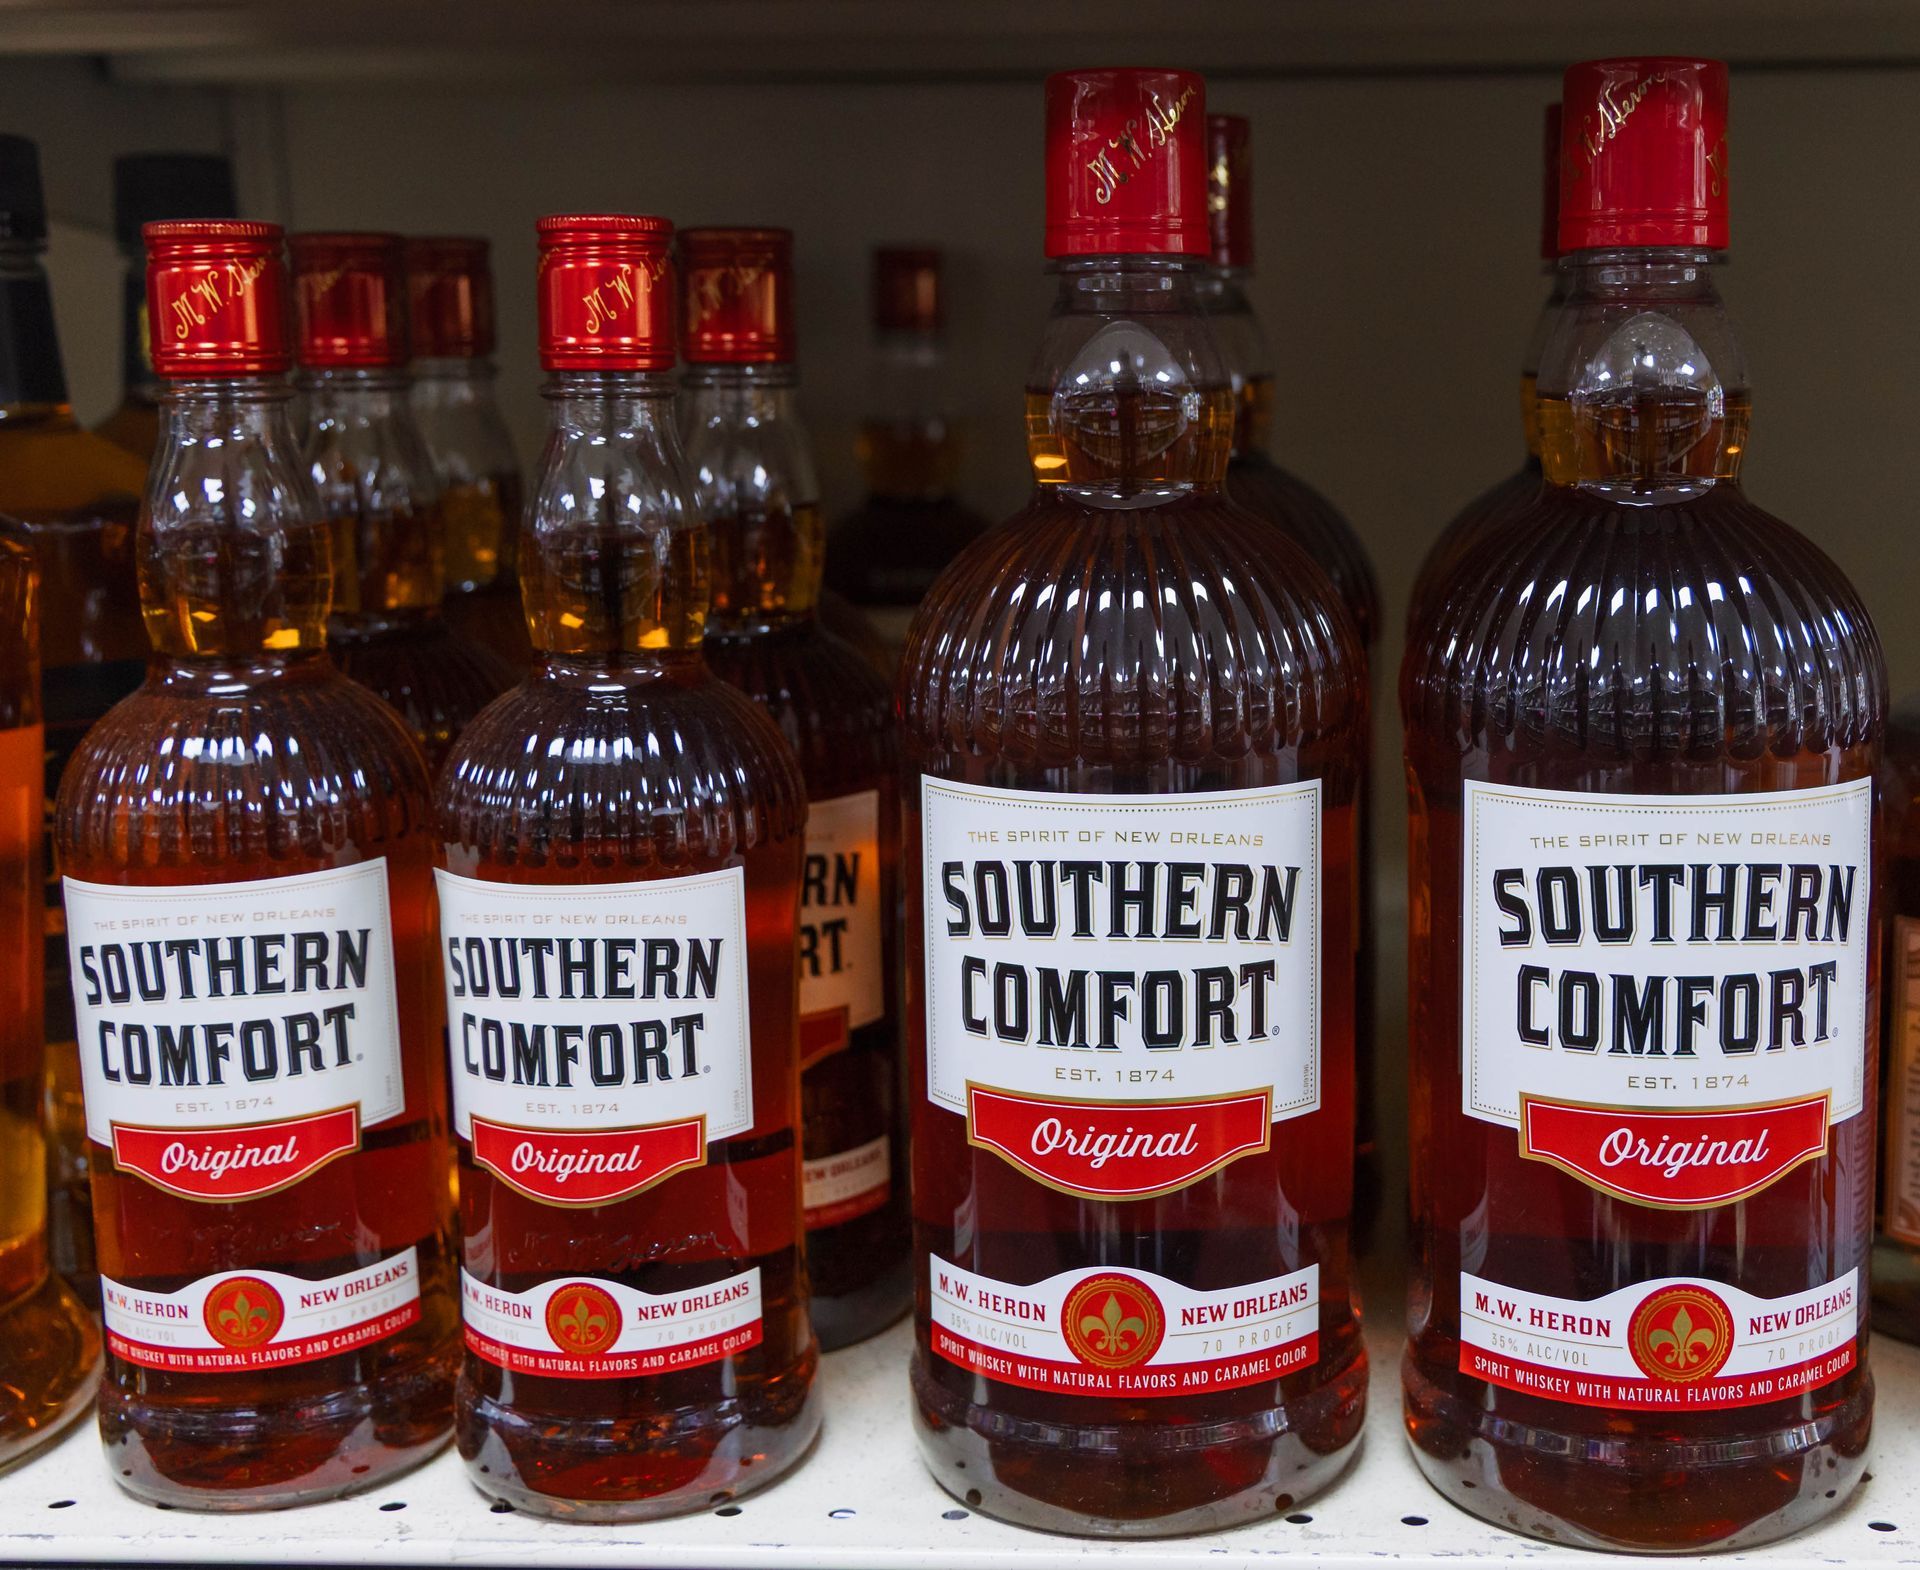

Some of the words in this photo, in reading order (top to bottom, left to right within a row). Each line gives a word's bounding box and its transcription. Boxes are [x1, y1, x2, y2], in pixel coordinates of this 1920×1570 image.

[968, 831, 999, 843] THE
[1007, 830, 1069, 843] SPIRIT
[1078, 830, 1105, 842] OF
[1115, 831, 1161, 844] NEW
[1170, 831, 1264, 848] ORLEANS
[1530, 836, 1569, 849] THE
[1579, 833, 1649, 847] SPIRIT
[1659, 833, 1688, 845] OF
[1697, 832, 1742, 845] NEW
[1750, 832, 1831, 846] ORLEANS
[94, 920, 116, 931] THE
[122, 916, 169, 930] SPIRIT
[177, 915, 199, 926] OF
[206, 913, 245, 925] NEW
[253, 907, 337, 922] ORLEANS
[459, 914, 480, 924] THE
[484, 914, 526, 924] SPIRIT
[533, 914, 553, 924] OF
[561, 914, 597, 925] NEW
[605, 914, 688, 925] ORLEANS
[941, 860, 1302, 945] SOUTHERN
[1493, 863, 1857, 950] SOUTHERN
[80, 929, 372, 1006] SOUTHERN
[448, 936, 725, 1001] SOUTHERN
[961, 955, 1275, 1052] COMFORT
[1517, 960, 1837, 1060] COMFORT
[99, 1002, 356, 1088] COMFORT
[463, 1012, 704, 1089] COMFORT
[1055, 1067, 1101, 1083] EST.
[1115, 1068, 1175, 1083] 1874
[1628, 1076, 1678, 1090] EST.
[1692, 1074, 1750, 1090] 1874
[175, 1101, 214, 1114] EST.
[225, 1096, 275, 1112] 1874
[526, 1103, 560, 1114] EST.
[571, 1102, 619, 1114] 1874
[160, 1135, 300, 1180] Original
[511, 1142, 642, 1183] Original
[1031, 1117, 1199, 1169] Original
[1599, 1127, 1769, 1179] Original
[301, 1286, 340, 1309] NEW
[344, 1261, 409, 1298] ORLEANS
[638, 1302, 678, 1321] NEW
[682, 1281, 749, 1314] ORLEANS
[940, 1272, 972, 1304] M.W.
[979, 1290, 1046, 1322] HERON
[1181, 1303, 1228, 1326] NEW
[1233, 1282, 1308, 1319] ORLEANS
[135, 1299, 189, 1319] HERON
[485, 1295, 532, 1320] HERON
[1475, 1292, 1522, 1322] M.W.
[1529, 1308, 1611, 1338] HERON
[1749, 1310, 1791, 1336] NEW
[1795, 1286, 1851, 1326] ORLEANS
[168, 1354, 194, 1366] WITH
[198, 1354, 248, 1367] NATURAL
[251, 1345, 302, 1364] FLAVORS
[306, 1340, 329, 1355] AND
[333, 1324, 381, 1348] CARAMEL
[512, 1353, 535, 1367] WITH
[538, 1358, 585, 1372] NATURAL
[589, 1358, 637, 1372] FLAVORS
[642, 1355, 665, 1368] AND
[669, 1342, 719, 1364] CARAMEL
[722, 1330, 752, 1350] COLOR
[977, 1324, 1027, 1349] ALC/VOL
[1202, 1339, 1222, 1354] 70
[1239, 1322, 1292, 1348] PROOF
[1492, 1333, 1518, 1353] 35%
[1526, 1342, 1589, 1366] ALC/VOL
[1768, 1347, 1785, 1363] 70
[1799, 1327, 1840, 1356] PROOF
[940, 1334, 965, 1359] SPIRIT
[968, 1348, 1013, 1375] WHISKEY
[1018, 1364, 1047, 1382] WITH
[1053, 1370, 1113, 1388] NATURAL
[1119, 1373, 1177, 1389] FLAVORS
[1183, 1370, 1209, 1386] AND
[1215, 1358, 1271, 1382] CARAMEL
[1275, 1345, 1307, 1368] COLOR
[1475, 1356, 1510, 1380] SPIRIT
[1515, 1368, 1570, 1394] WHISKEY
[1576, 1381, 1611, 1399] WITH
[1618, 1386, 1681, 1402] NATURAL
[1687, 1384, 1744, 1402] FLAVORS
[1749, 1380, 1773, 1397] AND
[1778, 1365, 1824, 1391] CARAMEL
[1827, 1350, 1850, 1375] COLOR
